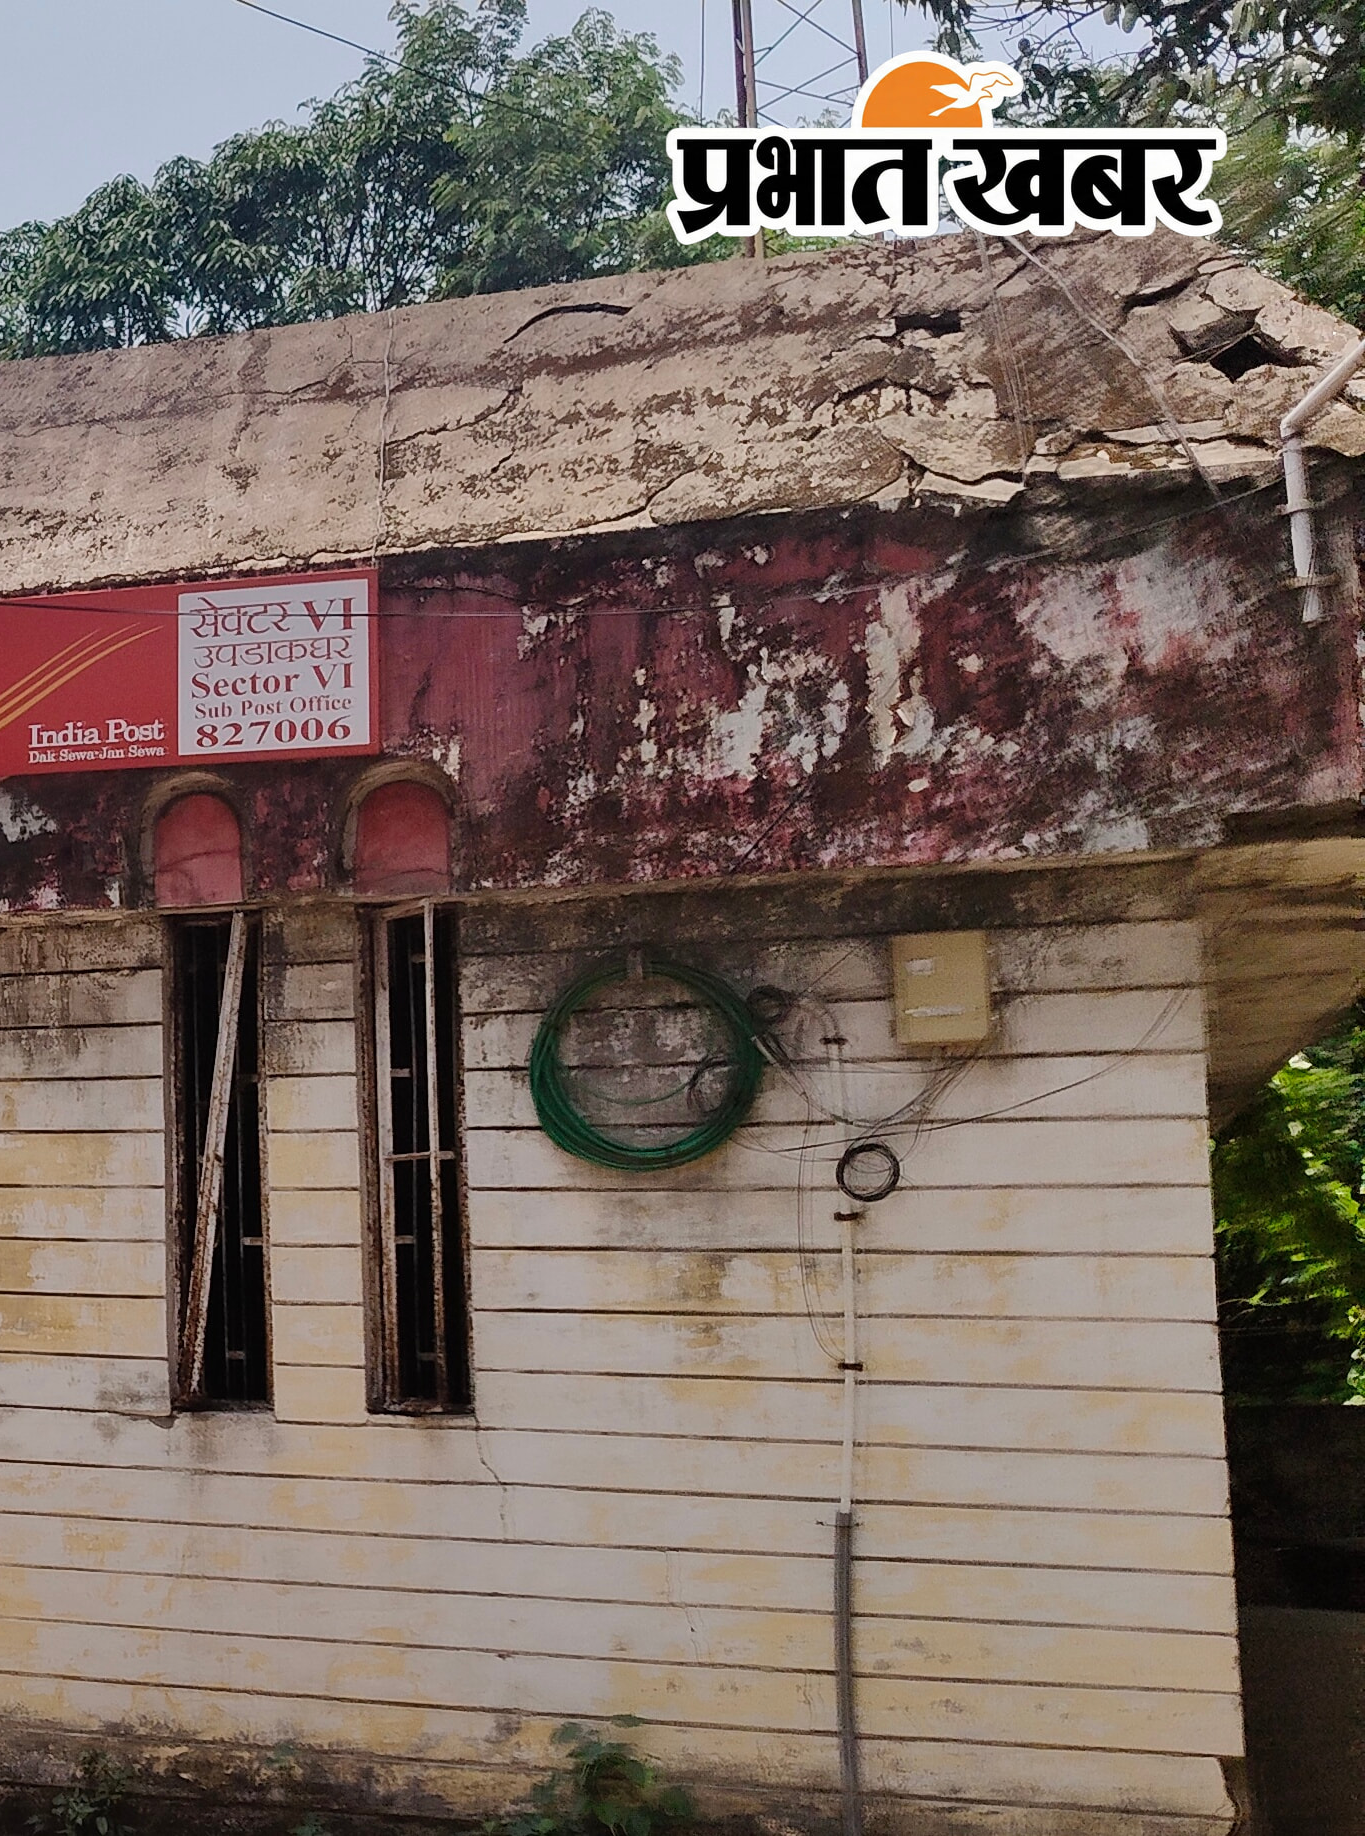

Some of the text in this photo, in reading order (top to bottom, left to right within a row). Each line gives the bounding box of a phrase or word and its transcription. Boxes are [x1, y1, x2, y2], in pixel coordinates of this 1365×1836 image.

[190, 597, 356, 638] सेक्टर VI
[193, 635, 352, 669] उपडाकघर
[191, 662, 355, 699] Sector VI
[195, 694, 352, 719] Sub Post Office
[28, 718, 165, 748] India Post
[196, 715, 351, 748] 827006
[28, 751, 56, 763] Dak
[129, 744, 165, 758] Sewa
